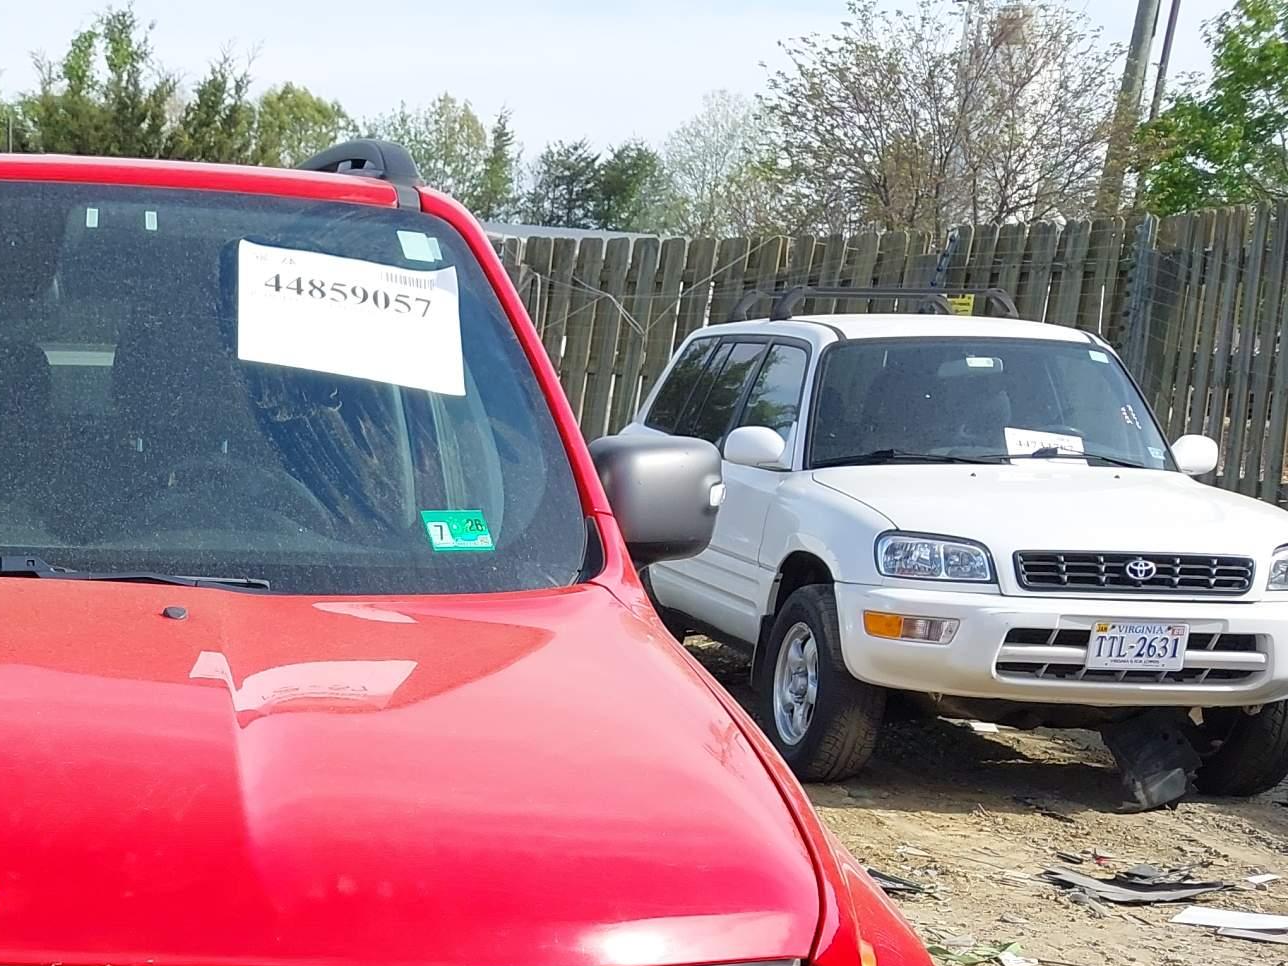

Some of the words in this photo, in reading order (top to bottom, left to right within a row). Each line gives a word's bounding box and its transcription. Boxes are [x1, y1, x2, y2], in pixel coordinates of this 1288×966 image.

[264, 272, 433, 318] 44859057
[434, 524, 444, 541] 7
[465, 518, 484, 532] 26
[1118, 625, 1164, 635] VIRGINIA
[1096, 636, 1179, 658] TTL-2631
